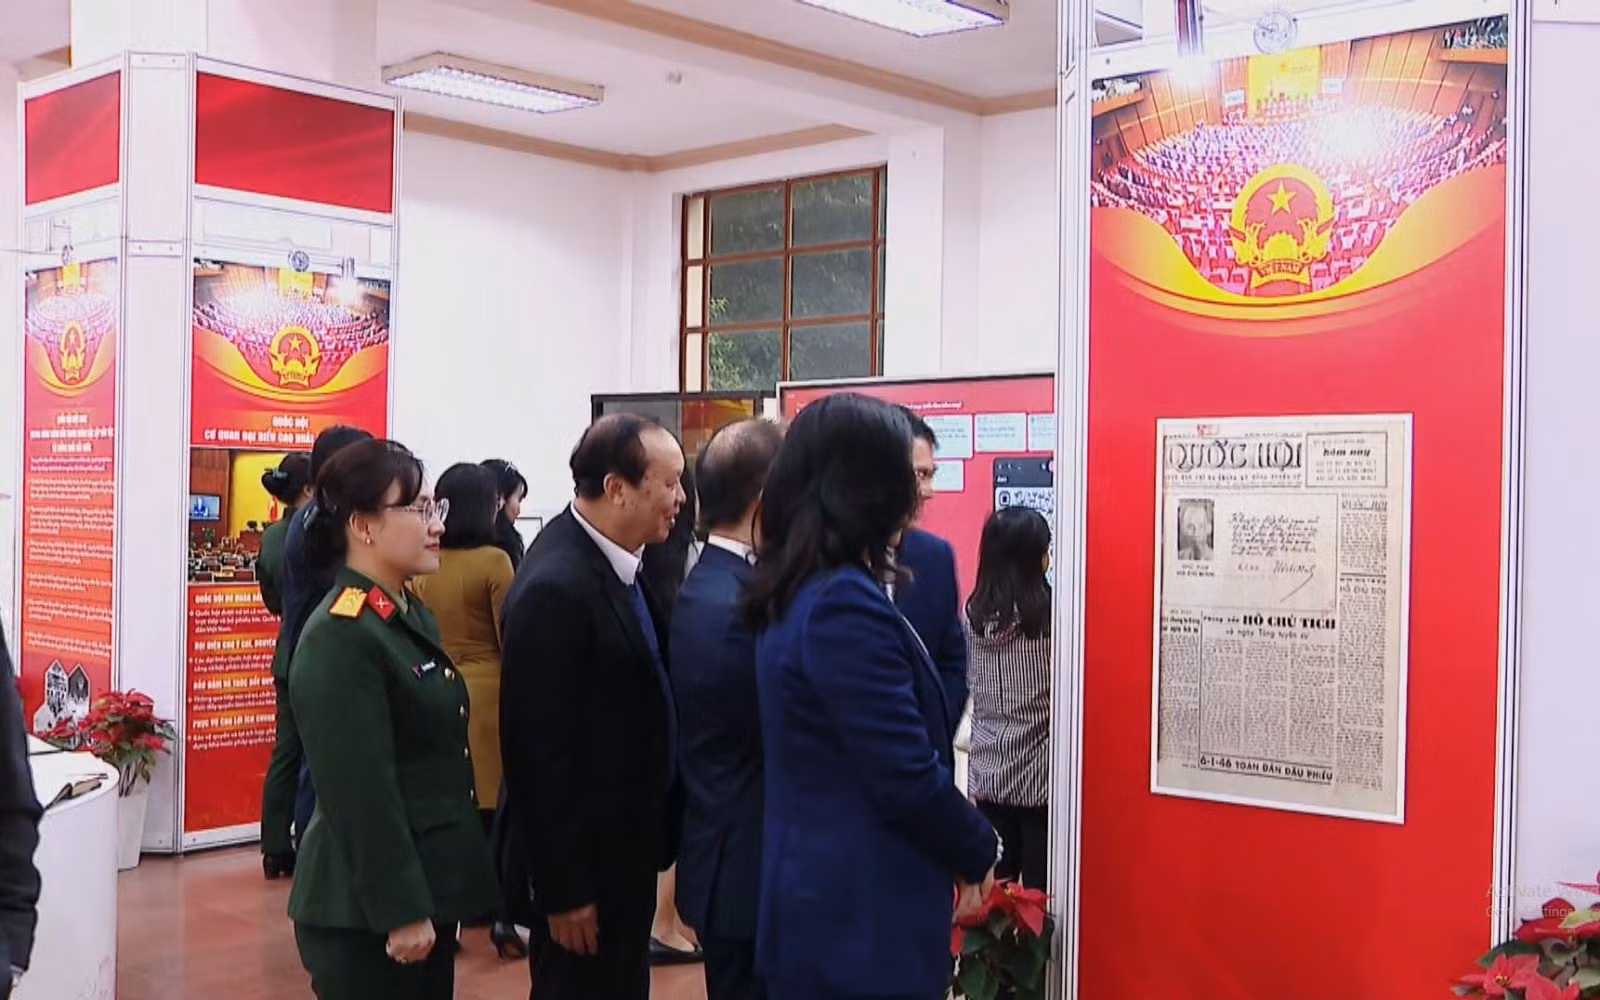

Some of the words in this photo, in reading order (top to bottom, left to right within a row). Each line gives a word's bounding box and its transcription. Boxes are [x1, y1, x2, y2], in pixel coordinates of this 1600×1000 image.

[272, 414, 294, 428] QUỐC
[295, 415, 309, 430] HỘI
[204, 429, 216, 440] CƠ
[218, 430, 240, 441] QUAN
[242, 430, 256, 444] ĐẠI
[258, 428, 276, 442] BIỂU
[278, 432, 294, 443] CAO
[295, 430, 315, 444] NHẤ
[252, 592, 264, 602] DÂ
[1243, 612, 1264, 626] HỒ
[1267, 614, 1297, 628] CHỦ
